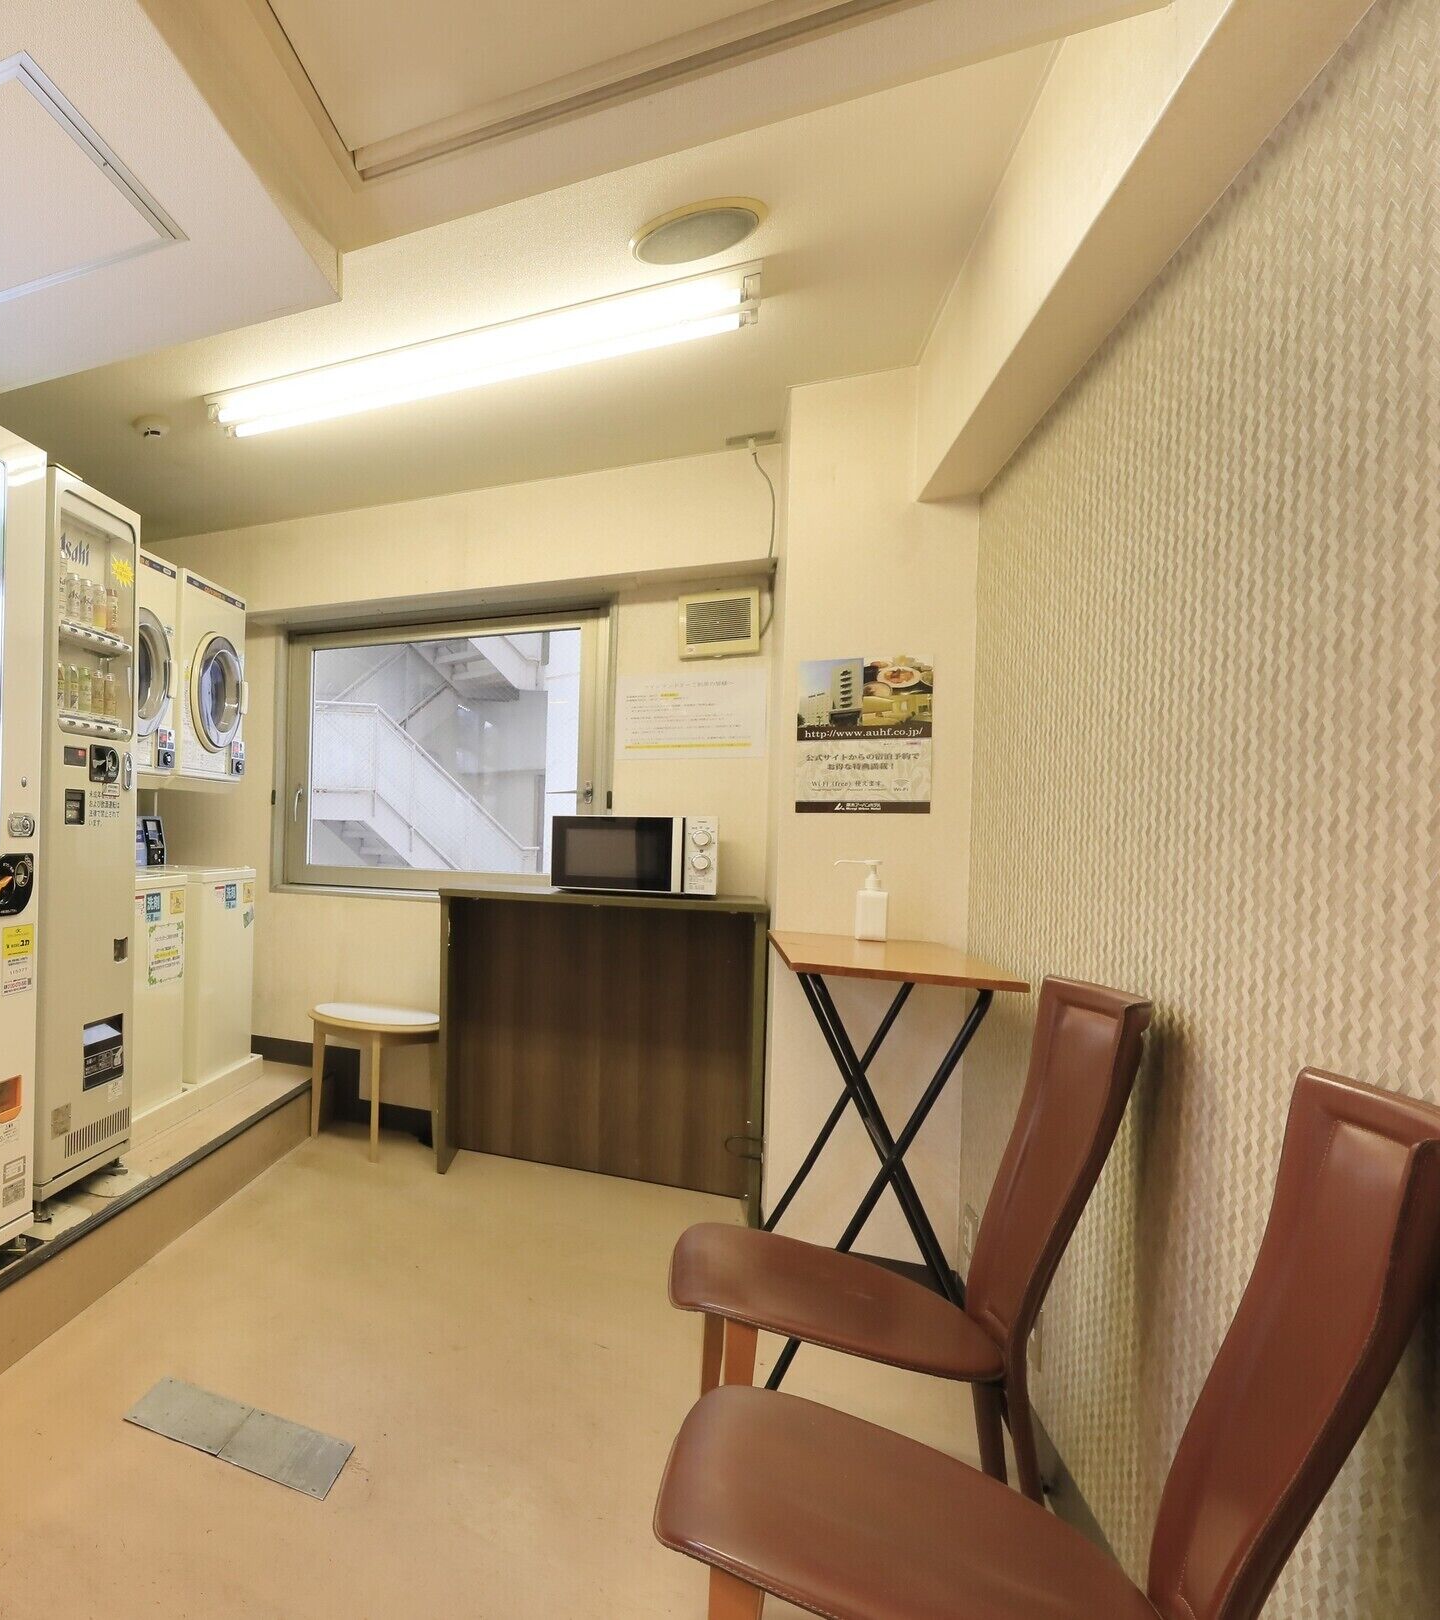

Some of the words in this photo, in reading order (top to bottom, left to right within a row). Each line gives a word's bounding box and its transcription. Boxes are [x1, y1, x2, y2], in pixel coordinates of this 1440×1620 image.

[805, 727, 924, 739] http://www.auhf.co.jp/
[806, 753, 920, 762] 公式サイトからの宿泊予約で
